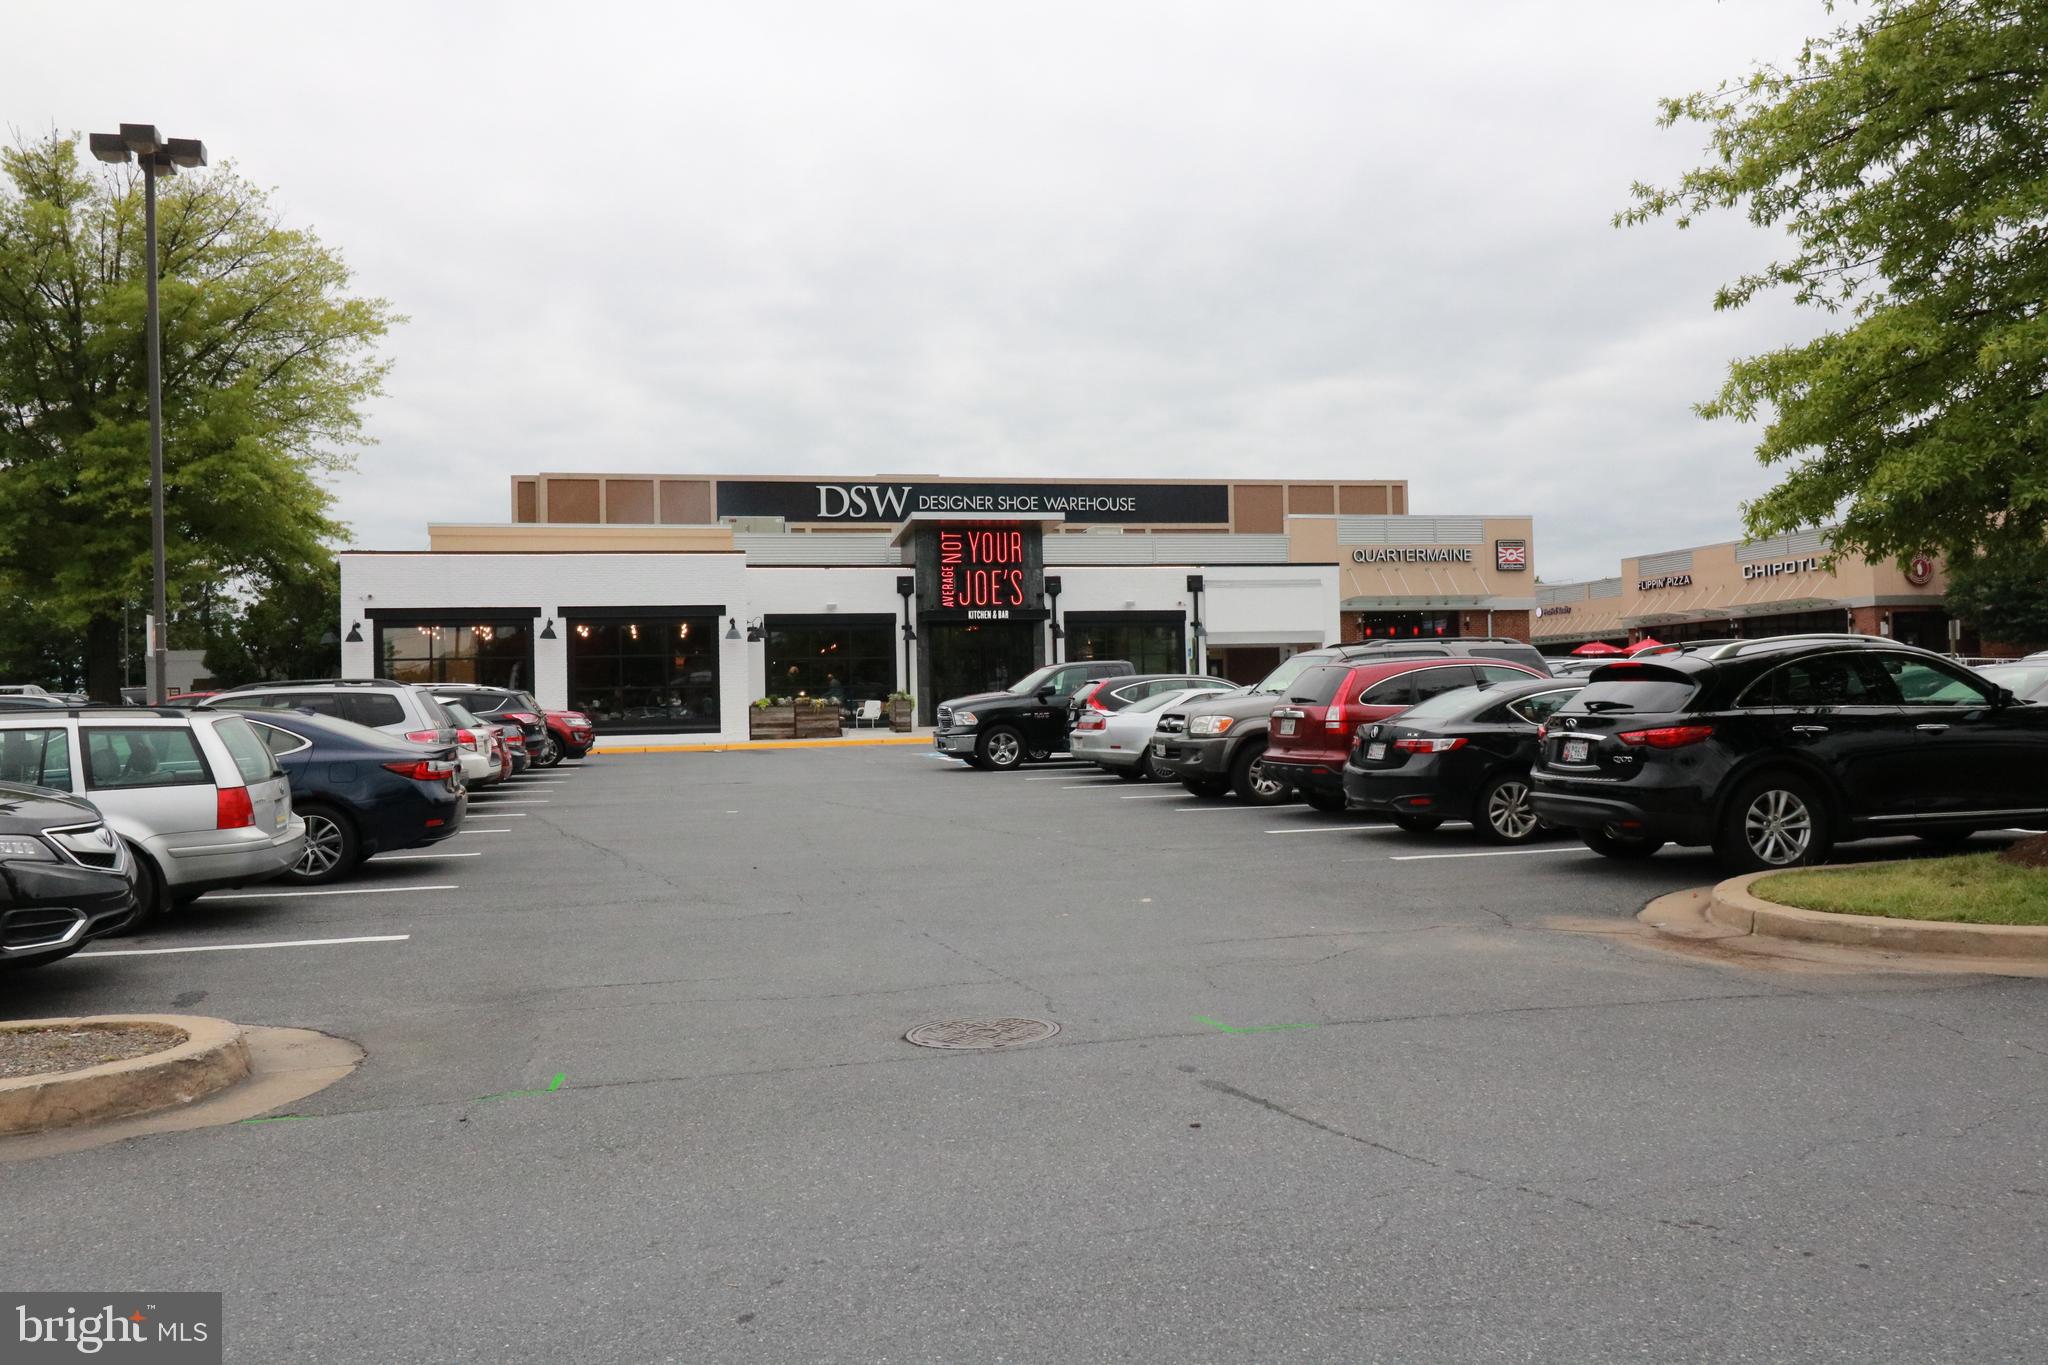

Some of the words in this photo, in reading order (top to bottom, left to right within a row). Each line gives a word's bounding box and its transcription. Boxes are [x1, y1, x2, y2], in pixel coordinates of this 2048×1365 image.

[816, 485, 912, 518] DSW
[919, 495, 994, 510] DESIGNER
[998, 496, 1039, 511] SHOE
[1044, 497, 1136, 511] WAREHOUSE
[941, 531, 963, 563] NOT
[968, 531, 1023, 563] YOUR
[1353, 548, 1473, 563] QUARTERMAINE
[1666, 575, 1691, 587] PIZZA
[1742, 557, 1826, 579] CHIPOTL
[941, 566, 955, 608] AVERAGE
[959, 569, 1023, 606] JOE'S
[968, 610, 991, 620] KITCHEN
[992, 610, 998, 620] &
[998, 610, 1009, 620] BAR
[1613, 755, 1633, 764] QX70
